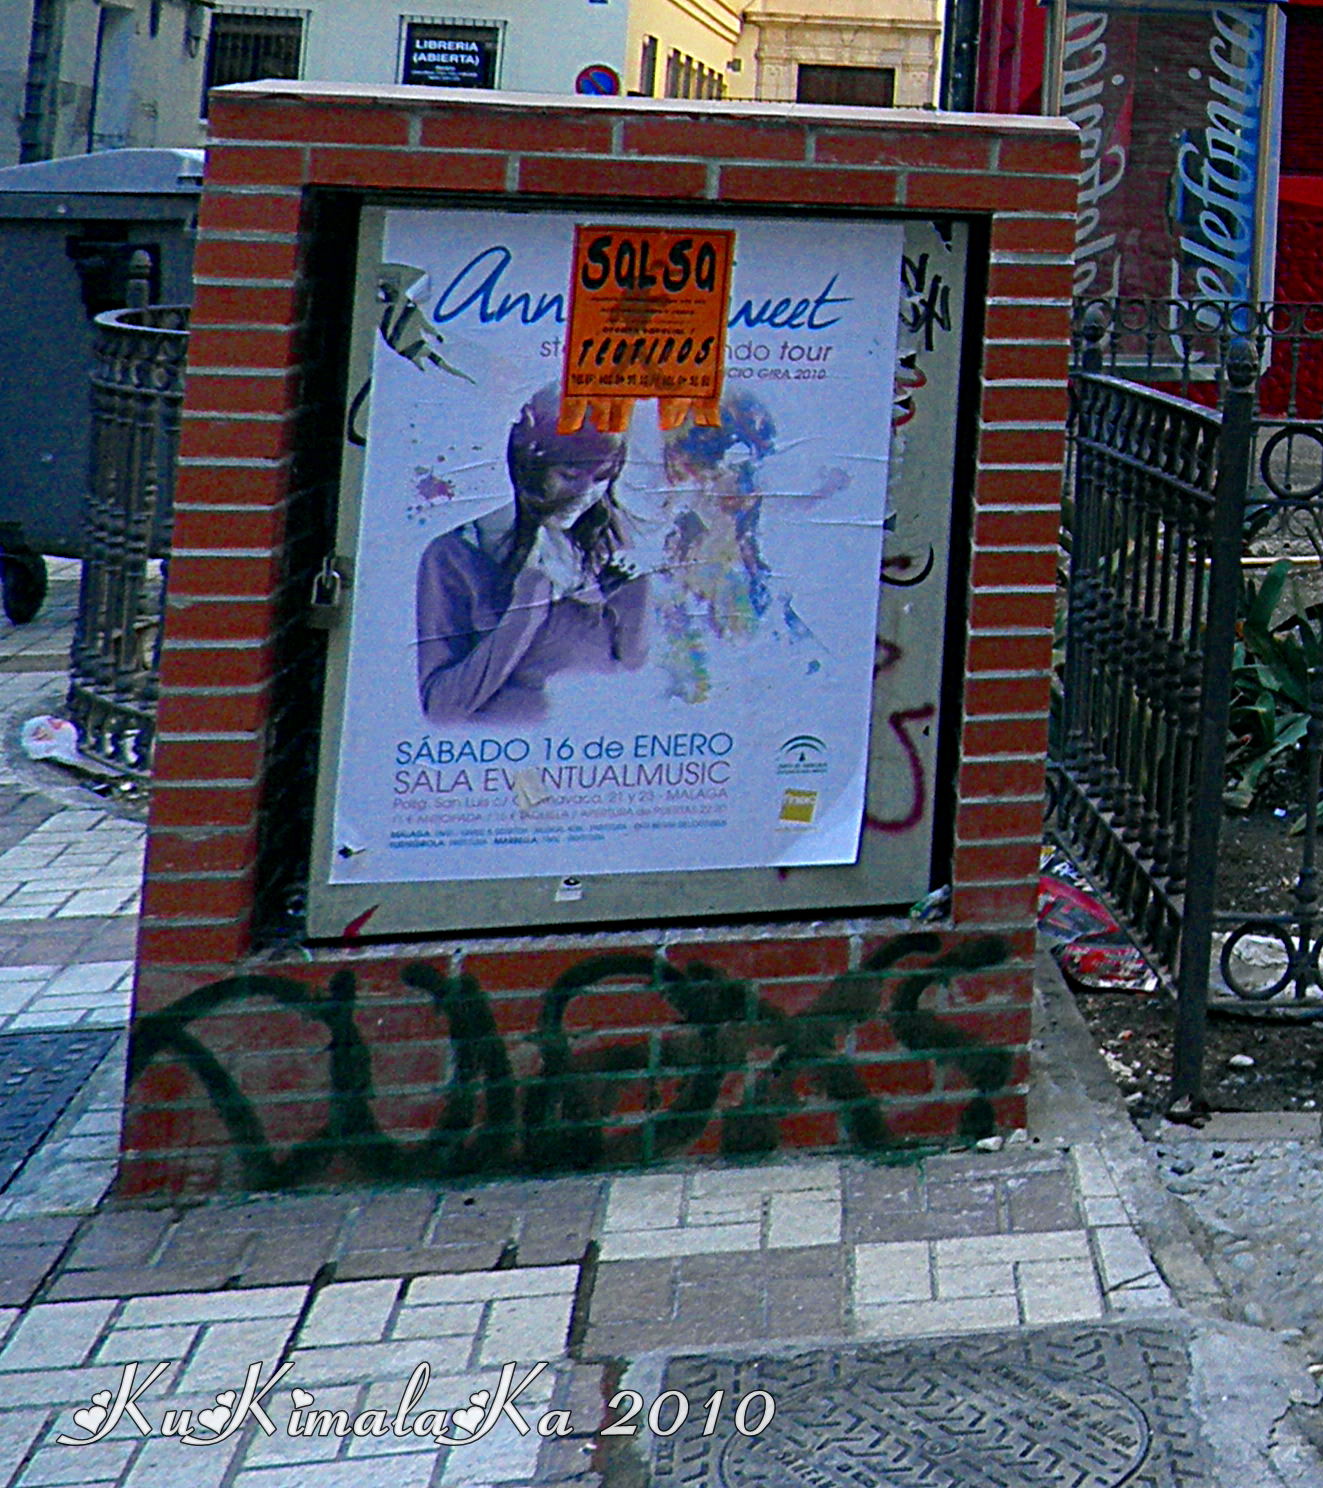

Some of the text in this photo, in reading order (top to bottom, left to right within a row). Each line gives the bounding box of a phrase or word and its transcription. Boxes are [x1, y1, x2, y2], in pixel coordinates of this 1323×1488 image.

[432, 244, 566, 325] Ann
[728, 272, 855, 331] weet
[779, 339, 833, 362] tour
[757, 367, 791, 381] GIRA
[793, 367, 827, 381] 2010
[395, 731, 734, 765] SÁBADO 16 de ENERO
[393, 760, 732, 795] SALA EVNTUALMUSIC
